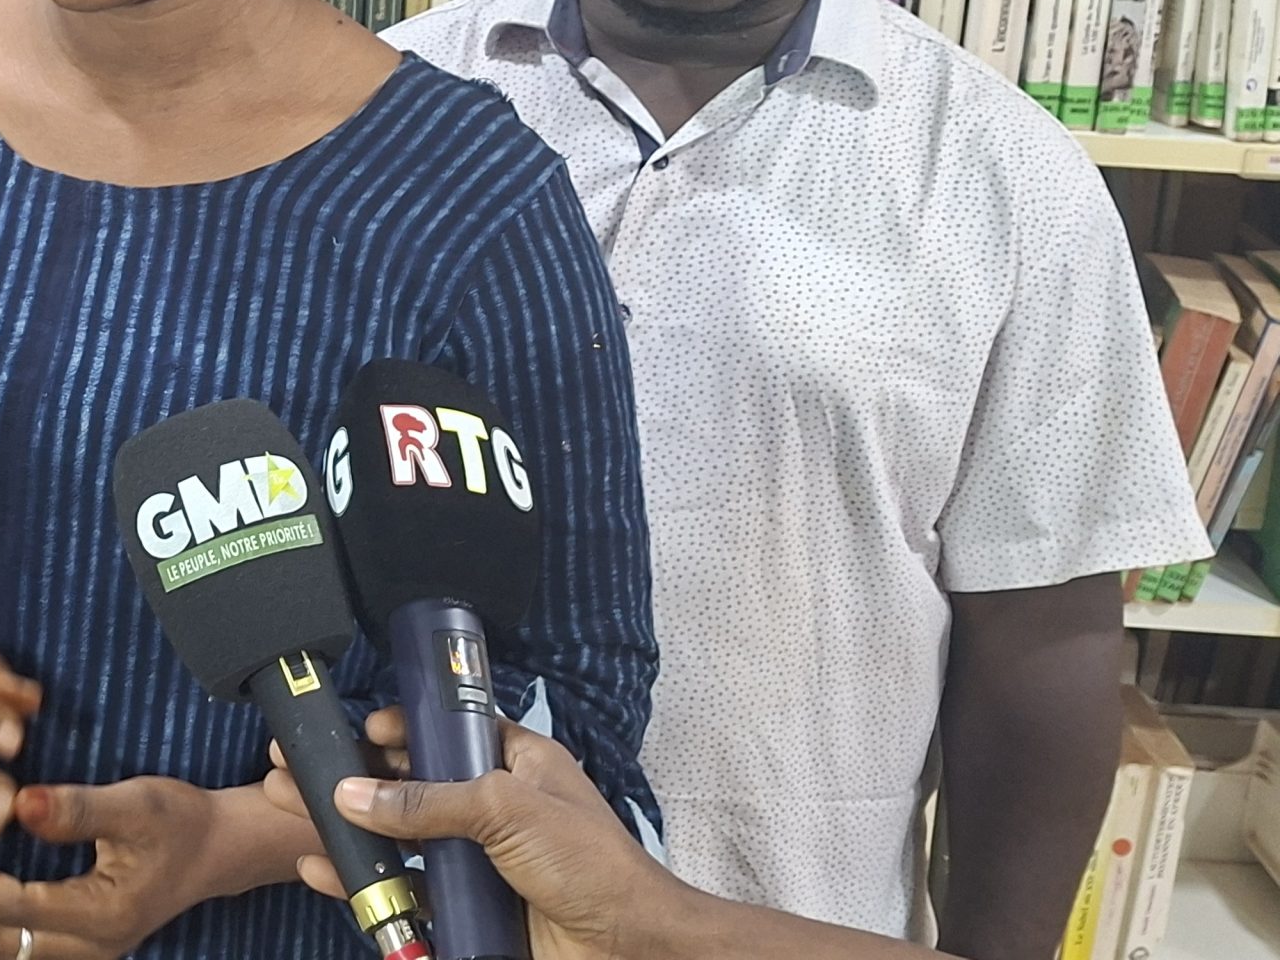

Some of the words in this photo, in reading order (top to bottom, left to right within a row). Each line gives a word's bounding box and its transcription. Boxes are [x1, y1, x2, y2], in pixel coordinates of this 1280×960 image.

[136, 451, 308, 560] GMD
[379, 404, 535, 512] RTG
[166, 565, 179, 583] LE
[179, 549, 220, 578] PEUPLE,
[220, 533, 259, 561] NOTRE
